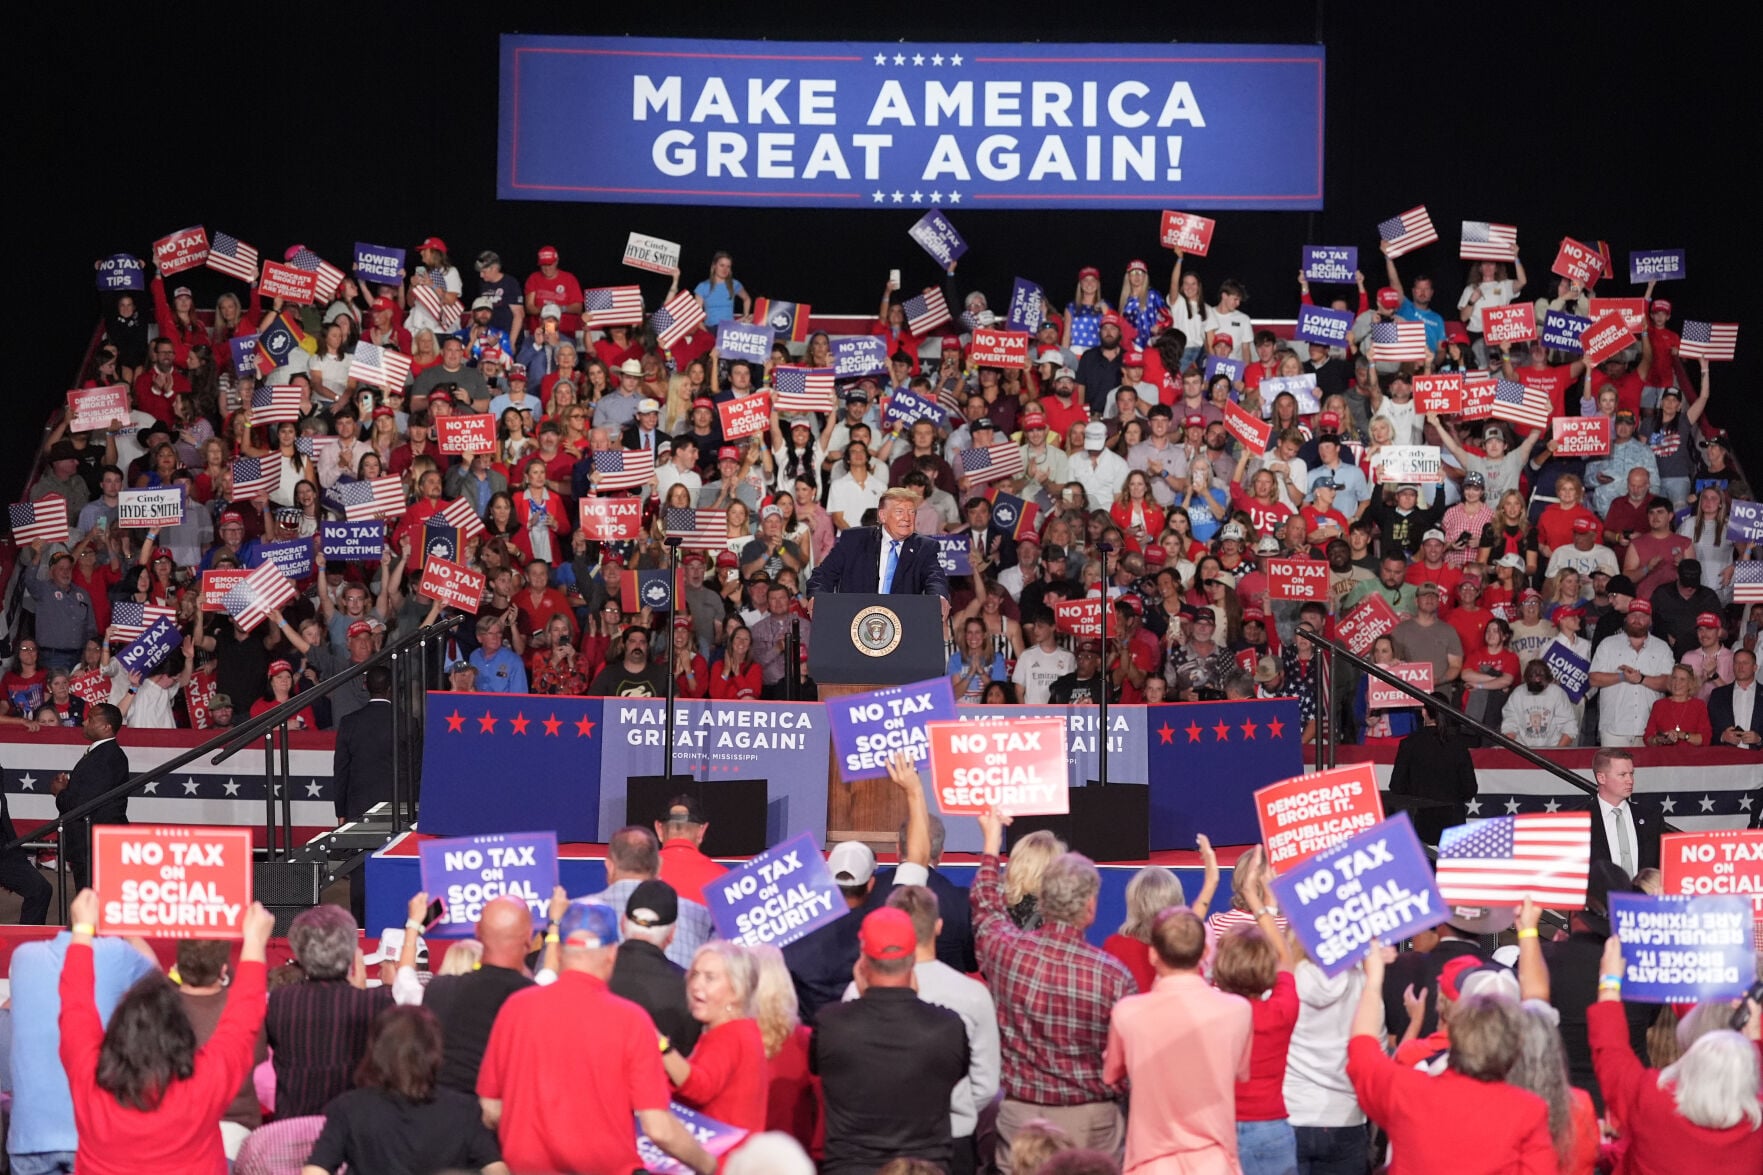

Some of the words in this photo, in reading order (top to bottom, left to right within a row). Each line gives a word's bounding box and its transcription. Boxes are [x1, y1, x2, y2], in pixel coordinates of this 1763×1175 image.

[633, 75, 837, 126] MAKE
[866, 80, 1206, 128] AMERICA
[651, 130, 893, 181] GREAT
[922, 136, 1184, 182] AGAIN!
[1170, 216, 1184, 226] NO
[157, 242, 176, 256] NO
[178, 234, 203, 249] TAX
[177, 248, 188, 257] ON
[644, 240, 668, 251] Cindy
[161, 250, 208, 270] OVERTIME
[358, 253, 399, 267] LOWER
[1312, 250, 1326, 259] NO
[1328, 250, 1348, 260] TAX
[1564, 245, 1583, 259] NO
[1584, 253, 1603, 272] TAX
[1636, 256, 1679, 265] LOWER
[100, 260, 116, 270] NO
[117, 259, 141, 269] TAX
[358, 263, 397, 277] PRICES
[1312, 263, 1347, 272] SOCIAL
[1637, 264, 1678, 274] PRICES
[1306, 270, 1353, 280] SECURITY
[1568, 264, 1591, 282] TIPS
[107, 276, 131, 286] TIPS
[1015, 288, 1025, 305] TAX
[1013, 306, 1021, 323] NO
[1490, 311, 1503, 319] NO
[1504, 308, 1525, 318] TAX
[1304, 314, 1347, 329] LOWER
[1491, 322, 1526, 334] SOCIAL
[1547, 316, 1565, 329] NO
[1567, 318, 1591, 333] TAX
[723, 330, 768, 344] LOWER
[1302, 325, 1345, 339] PRICES
[1487, 327, 1533, 342] SECURITY
[1562, 329, 1573, 338] ON
[1588, 325, 1618, 346] BIGGER
[722, 341, 765, 355] PRICES
[839, 343, 855, 352] NO
[856, 341, 877, 350] TAX
[975, 334, 996, 346] NO
[999, 338, 1024, 348] TAX
[841, 355, 877, 366] SOCIAL
[973, 353, 1025, 363] OVERTIME
[835, 361, 885, 374] SECURITY
[1270, 382, 1285, 392] NO
[1286, 380, 1308, 390] TAX
[1415, 381, 1433, 392] NO
[1435, 380, 1459, 391] TAX
[1472, 384, 1497, 398] TAX
[728, 404, 743, 414] NO
[744, 397, 764, 410] TAX
[895, 392, 916, 408] NO
[917, 401, 942, 422] TAX
[1424, 398, 1450, 409] TIPS
[1468, 398, 1480, 406] ON
[446, 420, 461, 430] NO
[463, 420, 485, 429] TAX
[731, 412, 767, 427] SOCIAL
[1563, 422, 1579, 431] NO
[1580, 421, 1601, 430] TAX
[442, 441, 492, 451] SECURITY
[447, 434, 486, 443] SOCIAL
[1564, 436, 1601, 445] SOCIAL
[1558, 442, 1606, 452] SECURITY
[137, 494, 166, 504] Cindy
[120, 503, 179, 518] HYDE-SMITH
[584, 504, 607, 515] NO
[609, 504, 638, 515] TAX
[605, 516, 618, 524] ON
[325, 527, 348, 538] NO
[351, 526, 380, 538] TAX
[596, 524, 627, 535] TIPS
[262, 544, 308, 559] DEMOCRATS
[323, 545, 381, 555] OVERTIME
[940, 540, 967, 550] TAX
[429, 562, 450, 578] NO
[453, 571, 480, 590] TAX
[1271, 565, 1293, 576] NO
[1296, 566, 1325, 577] TAX
[446, 580, 459, 589] ON
[1282, 585, 1314, 596] TIPS
[423, 581, 477, 607] OVERTIME
[1059, 608, 1078, 617] NO
[1081, 616, 1094, 624] ON
[1339, 621, 1356, 636] NO
[1353, 605, 1374, 623] TAX
[1071, 624, 1102, 634] TIPS
[1349, 616, 1384, 646] SOCIAL
[123, 646, 145, 665] NO
[143, 621, 170, 646] TAX
[147, 644, 159, 655] ON
[144, 643, 170, 668] TIPS
[1548, 652, 1589, 685] LOWER
[84, 674, 105, 686] TAX
[849, 705, 885, 724] NO
[888, 693, 934, 717] TAX
[195, 708, 207, 729] NO
[620, 708, 689, 726] MAKE
[699, 710, 812, 729] AMERICA
[884, 717, 905, 730] ON
[627, 729, 708, 747] GREAT
[717, 732, 805, 750] AGAIN!
[950, 734, 990, 754] NO
[992, 732, 1042, 751] TAX
[672, 752, 710, 760] CORINTH,
[985, 753, 1007, 765] ON
[953, 766, 1042, 787] SOCIAL
[942, 784, 1058, 806] SECURITY
[1267, 781, 1363, 816] DEMOCRATS
[1276, 804, 1331, 827] BROKE
[1334, 798, 1354, 813] IT.
[1268, 812, 1375, 850] REPUBLICANS
[121, 842, 163, 865] NO
[169, 843, 224, 866] TAX
[445, 850, 483, 871] NO
[488, 845, 536, 867] TAX
[1271, 845, 1298, 864] ARE
[1681, 845, 1715, 863] NO
[1721, 843, 1763, 861] TAX
[160, 866, 185, 880] ON
[481, 868, 503, 880] ON
[1294, 869, 1335, 905] NO
[1333, 839, 1395, 881] TAX
[1713, 863, 1734, 874] ON
[723, 878, 758, 905] NO
[758, 850, 802, 886] TAX
[1680, 875, 1763, 895] SOCIAL
[121, 880, 224, 903] SOCIAL
[447, 880, 537, 905] SOCIAL
[759, 883, 779, 901] ON
[1336, 878, 1363, 900] ON
[105, 901, 241, 927] SECURITY
[736, 883, 817, 933] SOCIAL
[1314, 879, 1411, 939] SOCIAL
[1616, 910, 1635, 926] IT.
[1637, 912, 1698, 929] FIXING
[1700, 912, 1743, 927] ARE
[1315, 888, 1431, 966] SECURITY
[1618, 928, 1744, 945] REPUBLICANS
[1636, 950, 1656, 967] IT.
[1658, 952, 1725, 968] BROKE
[1627, 966, 1739, 983] DEMOCRATS
